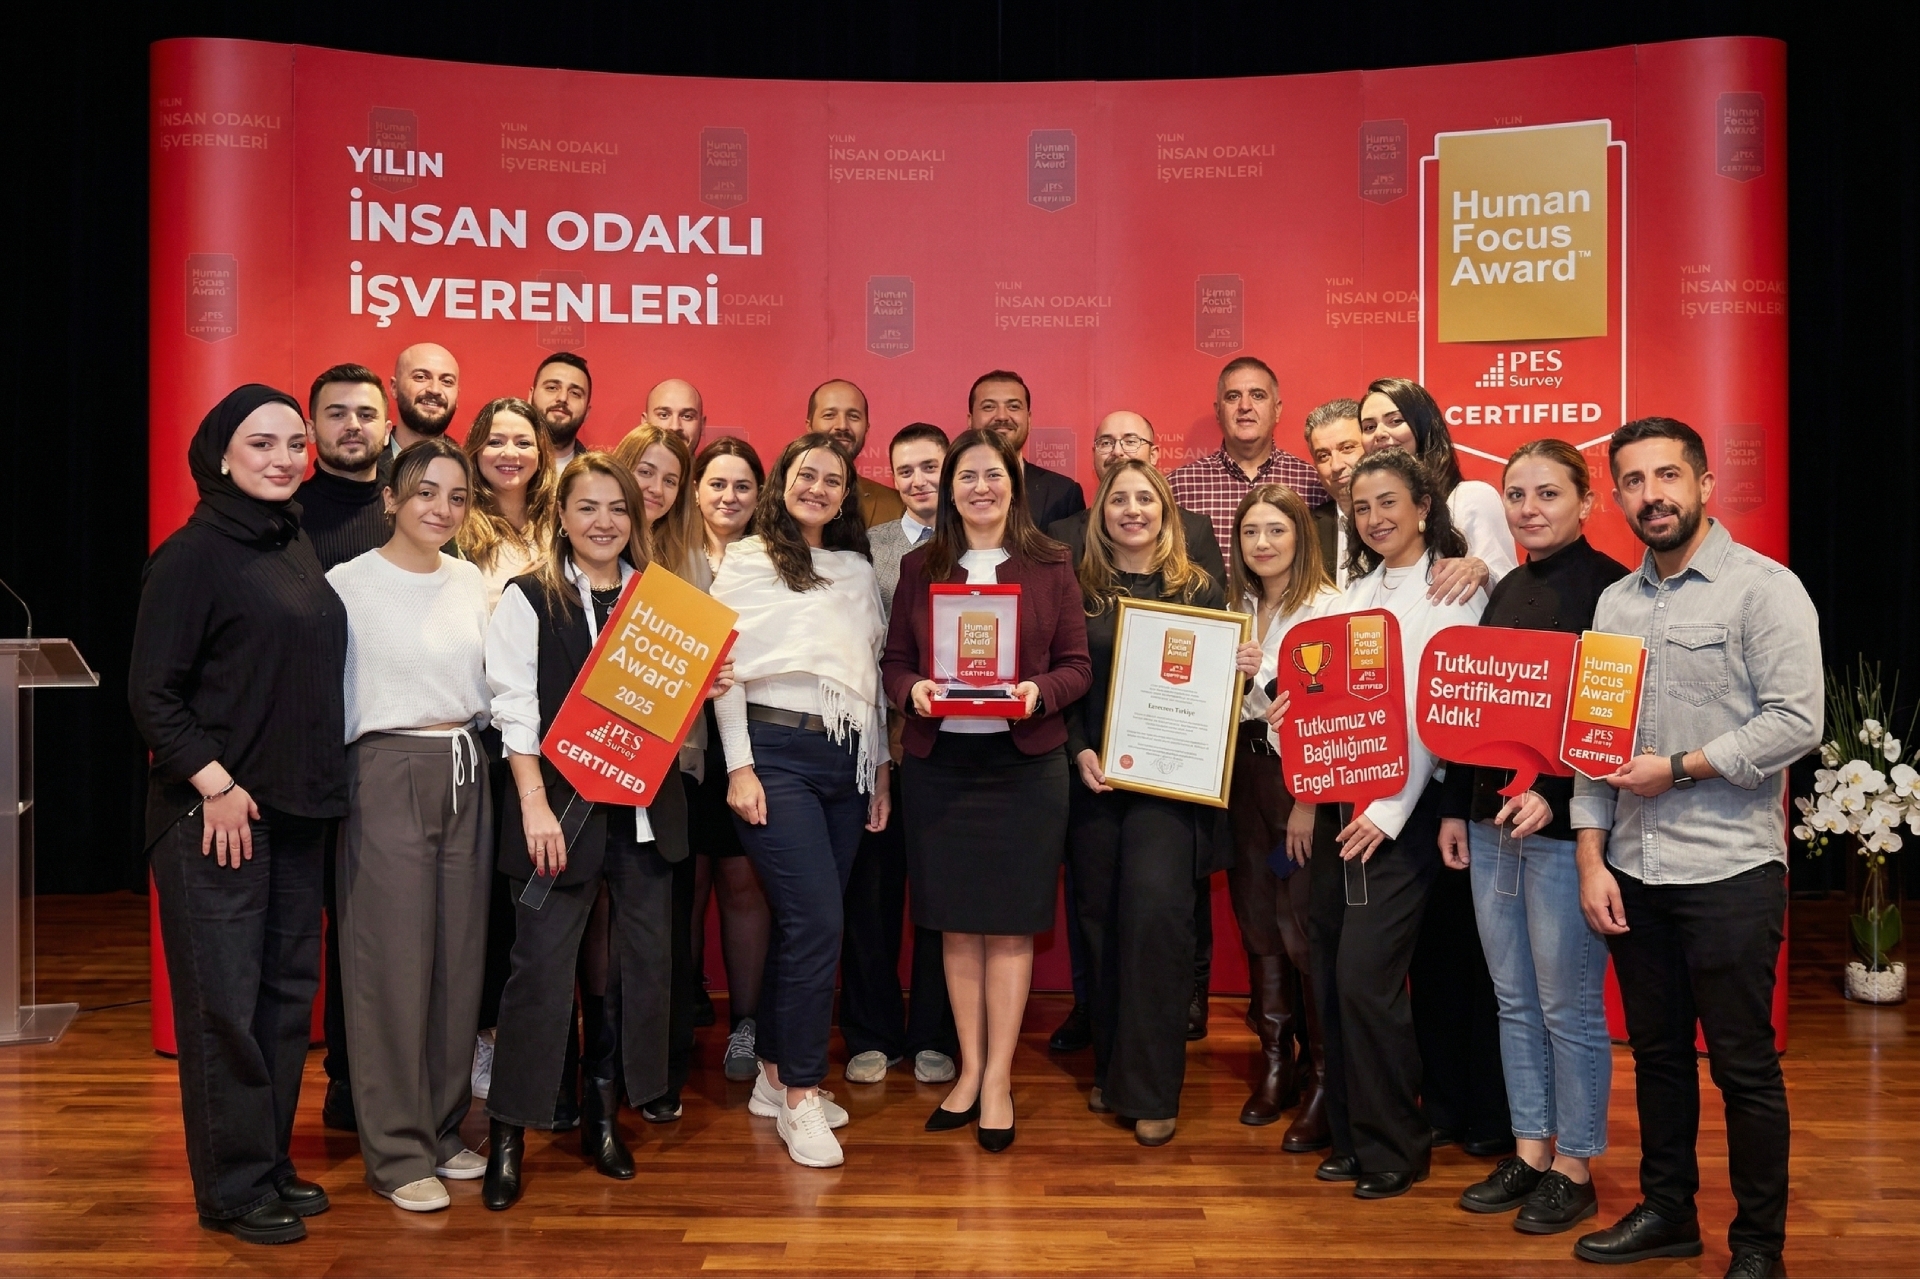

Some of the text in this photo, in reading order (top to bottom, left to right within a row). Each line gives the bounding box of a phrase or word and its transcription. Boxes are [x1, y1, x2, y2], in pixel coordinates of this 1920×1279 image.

[212, 112, 281, 129] ODAKLI
[500, 122, 528, 132] YILIN
[1494, 115, 1523, 126] YILIN
[160, 132, 268, 151] İŞVERENLERİ
[501, 133, 618, 155] İNSAN ODAKLI
[828, 134, 856, 143] YILIN
[1156, 133, 1184, 142] YILIN
[829, 145, 945, 161] İNSAN ODAKLI
[1157, 144, 1275, 160] İNSAN ODAKLI
[346, 146, 443, 178] YILIN
[501, 154, 607, 174] İŞVERENLERİ
[829, 164, 934, 184] İŞVERENLERİ
[1157, 161, 1263, 183] İŞVERENLERİ
[1453, 189, 1590, 221] Human
[350, 187, 762, 255] İNSAN ODAKLI
[1453, 223, 1572, 253] Focus
[1681, 264, 1711, 274] YILIN
[995, 281, 1022, 290] YILIN
[1325, 277, 1354, 286] YILIN
[1681, 278, 1737, 294] İNSAN
[350, 260, 718, 328] İŞVERENLERİ
[722, 293, 784, 306] ODAKLI
[995, 292, 1111, 308] İNSAN ODAKLI
[1326, 289, 1377, 305] İNSAN
[995, 312, 1100, 331] İŞVERENLERİ
[1510, 349, 1563, 373] PES
[1509, 374, 1563, 388] Survey
[1444, 403, 1602, 426] CERTIFIED
[1157, 433, 1184, 442] YILIN
[630, 600, 710, 661] Human
[964, 623, 994, 631] Human
[1353, 631, 1380, 639] Human
[620, 622, 689, 676] Focus
[1433, 651, 1549, 683] Tutkuluyuz!
[1584, 656, 1633, 675] Human
[1583, 670, 1624, 688] Focus
[615, 685, 655, 716] 2025
[1430, 677, 1552, 709] Sertifikamızı
[1426, 703, 1481, 728] Aldık!
[1590, 706, 1613, 718] 2025
[1294, 708, 1386, 738] Tutkumuz ve
[610, 723, 644, 751] PES
[1594, 729, 1614, 741] PES
[605, 738, 636, 761] Survey
[1303, 735, 1388, 766] Bağlılığımız
[1568, 747, 1624, 765] CERTIFIED
[556, 738, 646, 794] CERTIFIED
[1292, 756, 1405, 795] Engel Tanımaz!
